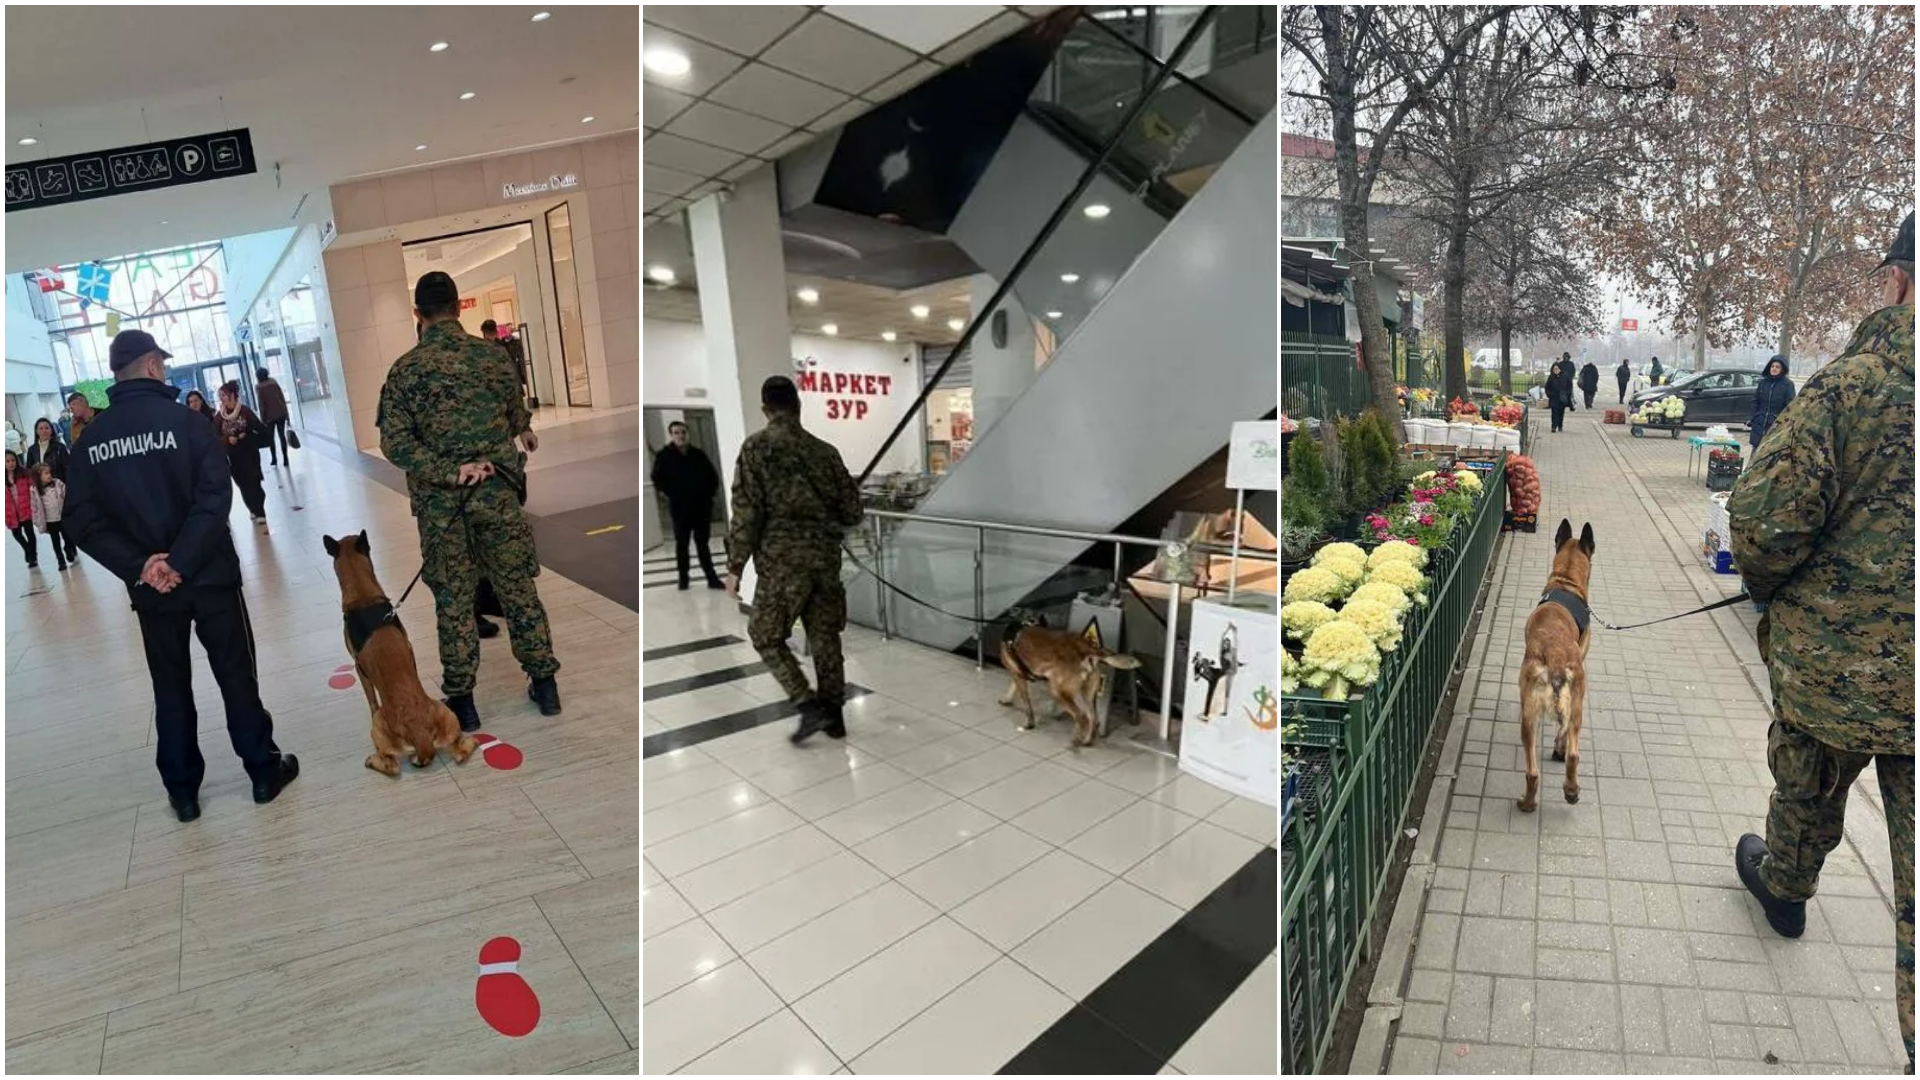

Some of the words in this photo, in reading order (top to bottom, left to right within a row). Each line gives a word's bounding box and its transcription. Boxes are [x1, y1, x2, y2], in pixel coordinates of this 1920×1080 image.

[797, 370, 891, 395] МАРКЕТ
[827, 399, 868, 420] ЗУР
[88, 430, 177, 465] ПОЛИЦИЈА
